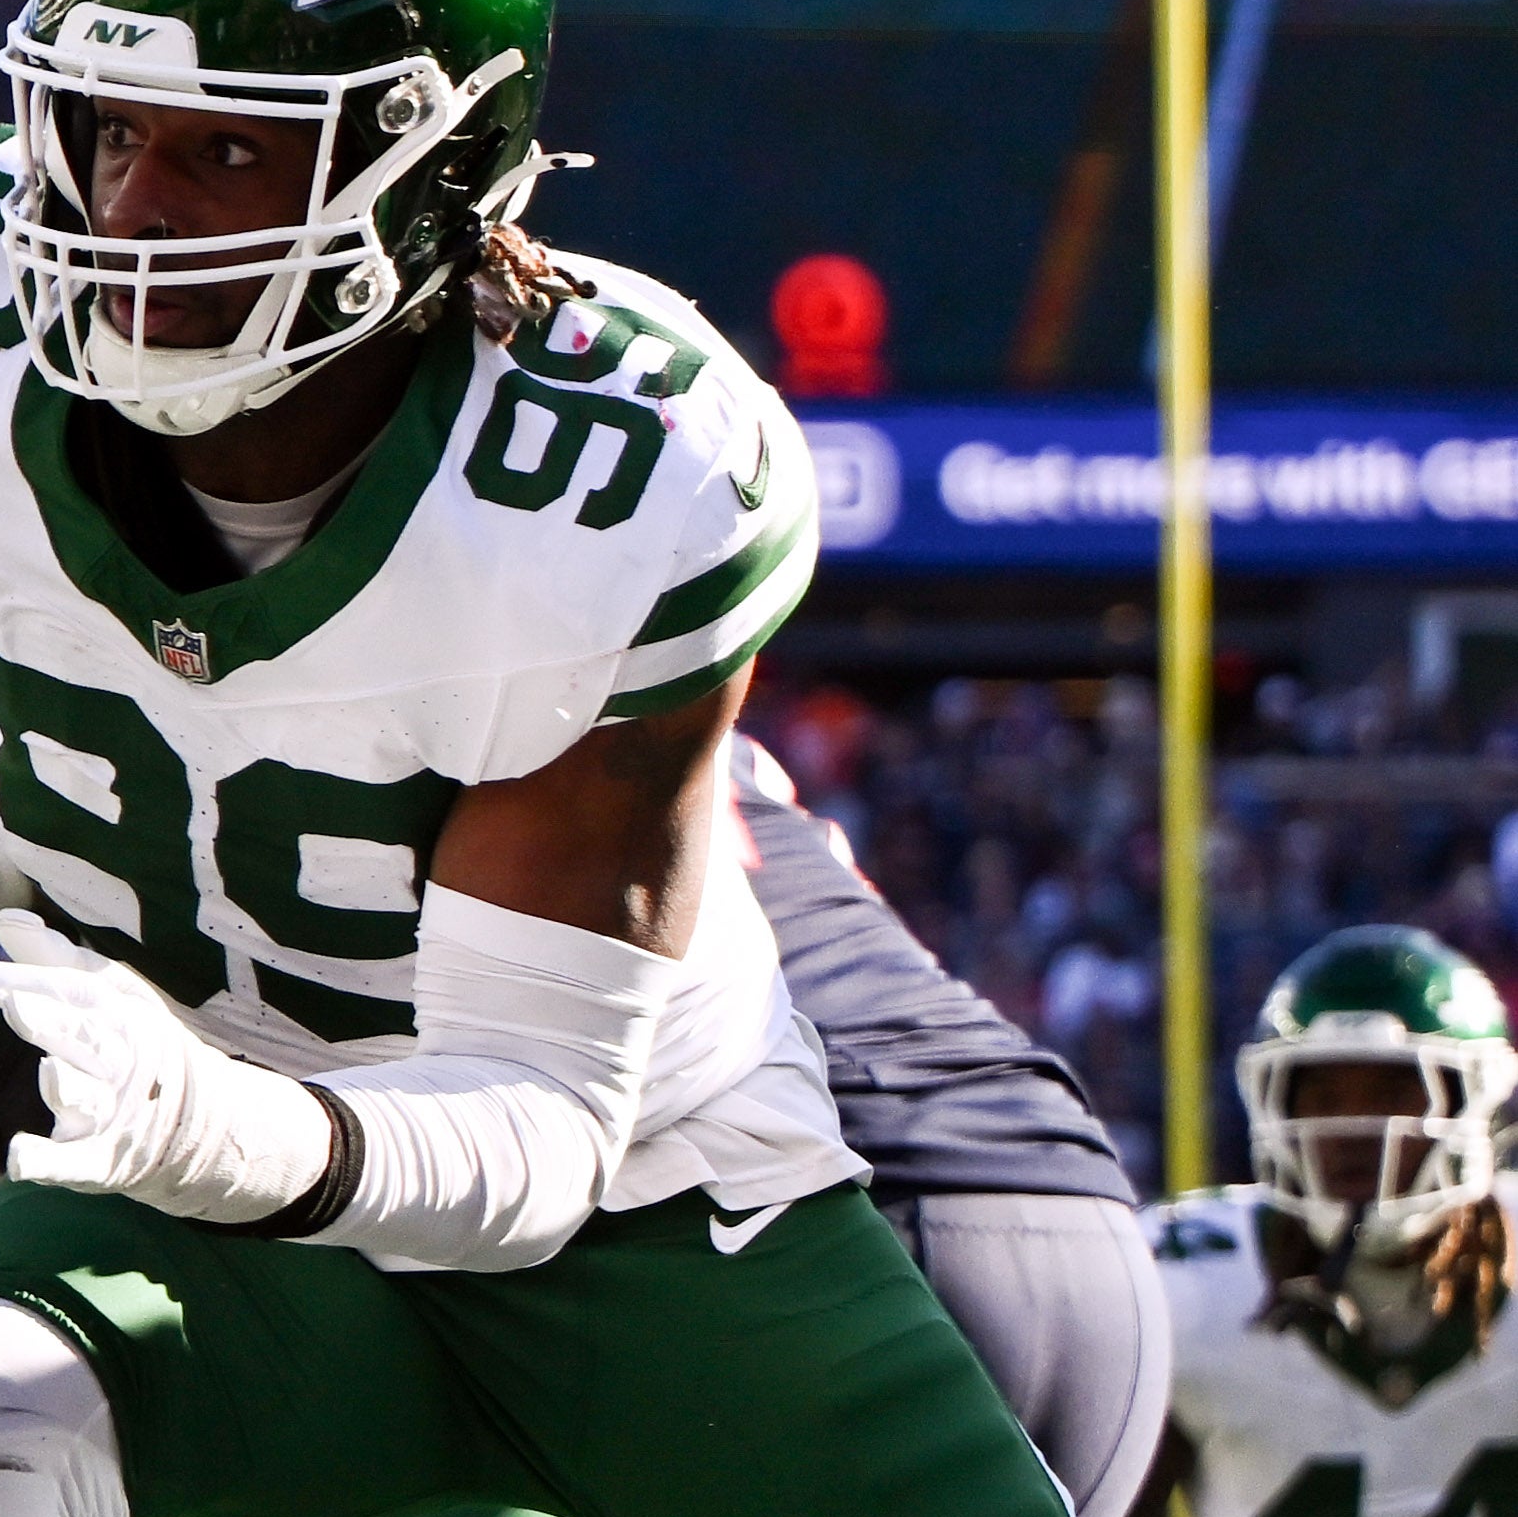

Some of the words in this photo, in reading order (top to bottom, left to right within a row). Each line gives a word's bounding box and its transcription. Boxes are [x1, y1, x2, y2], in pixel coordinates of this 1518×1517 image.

[84, 19, 156, 48] NY
[462, 298, 712, 531] 99
[161, 647, 203, 675] NFL
